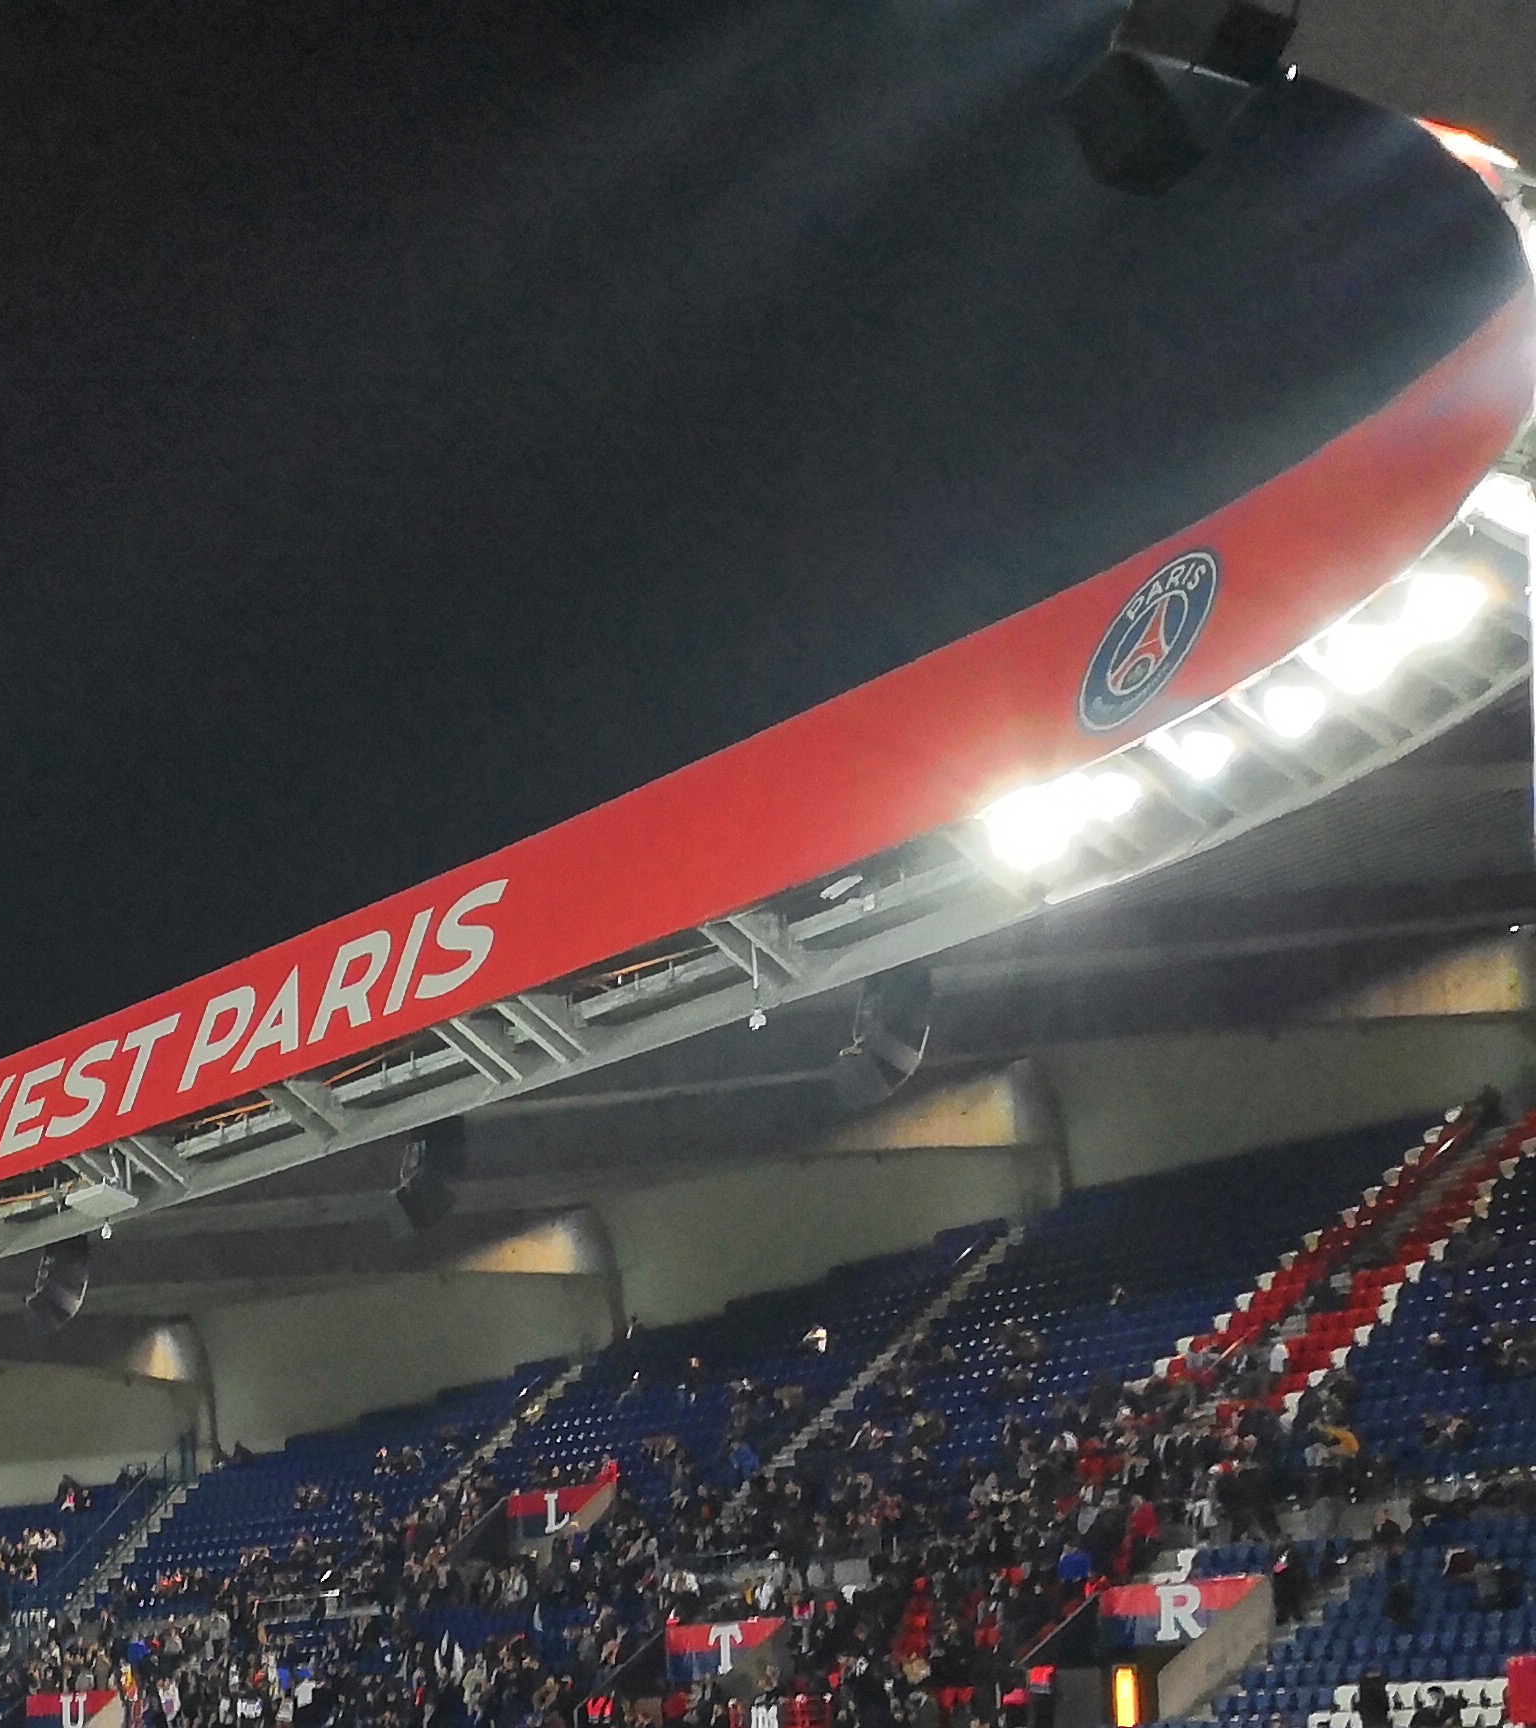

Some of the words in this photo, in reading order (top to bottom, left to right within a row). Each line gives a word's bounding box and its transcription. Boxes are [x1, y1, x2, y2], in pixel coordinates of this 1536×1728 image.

[1126, 562, 1207, 621] PARIS
[175, 879, 510, 1094] PARIS
[1154, 1583, 1207, 1643] R
[707, 1624, 743, 1675] T
